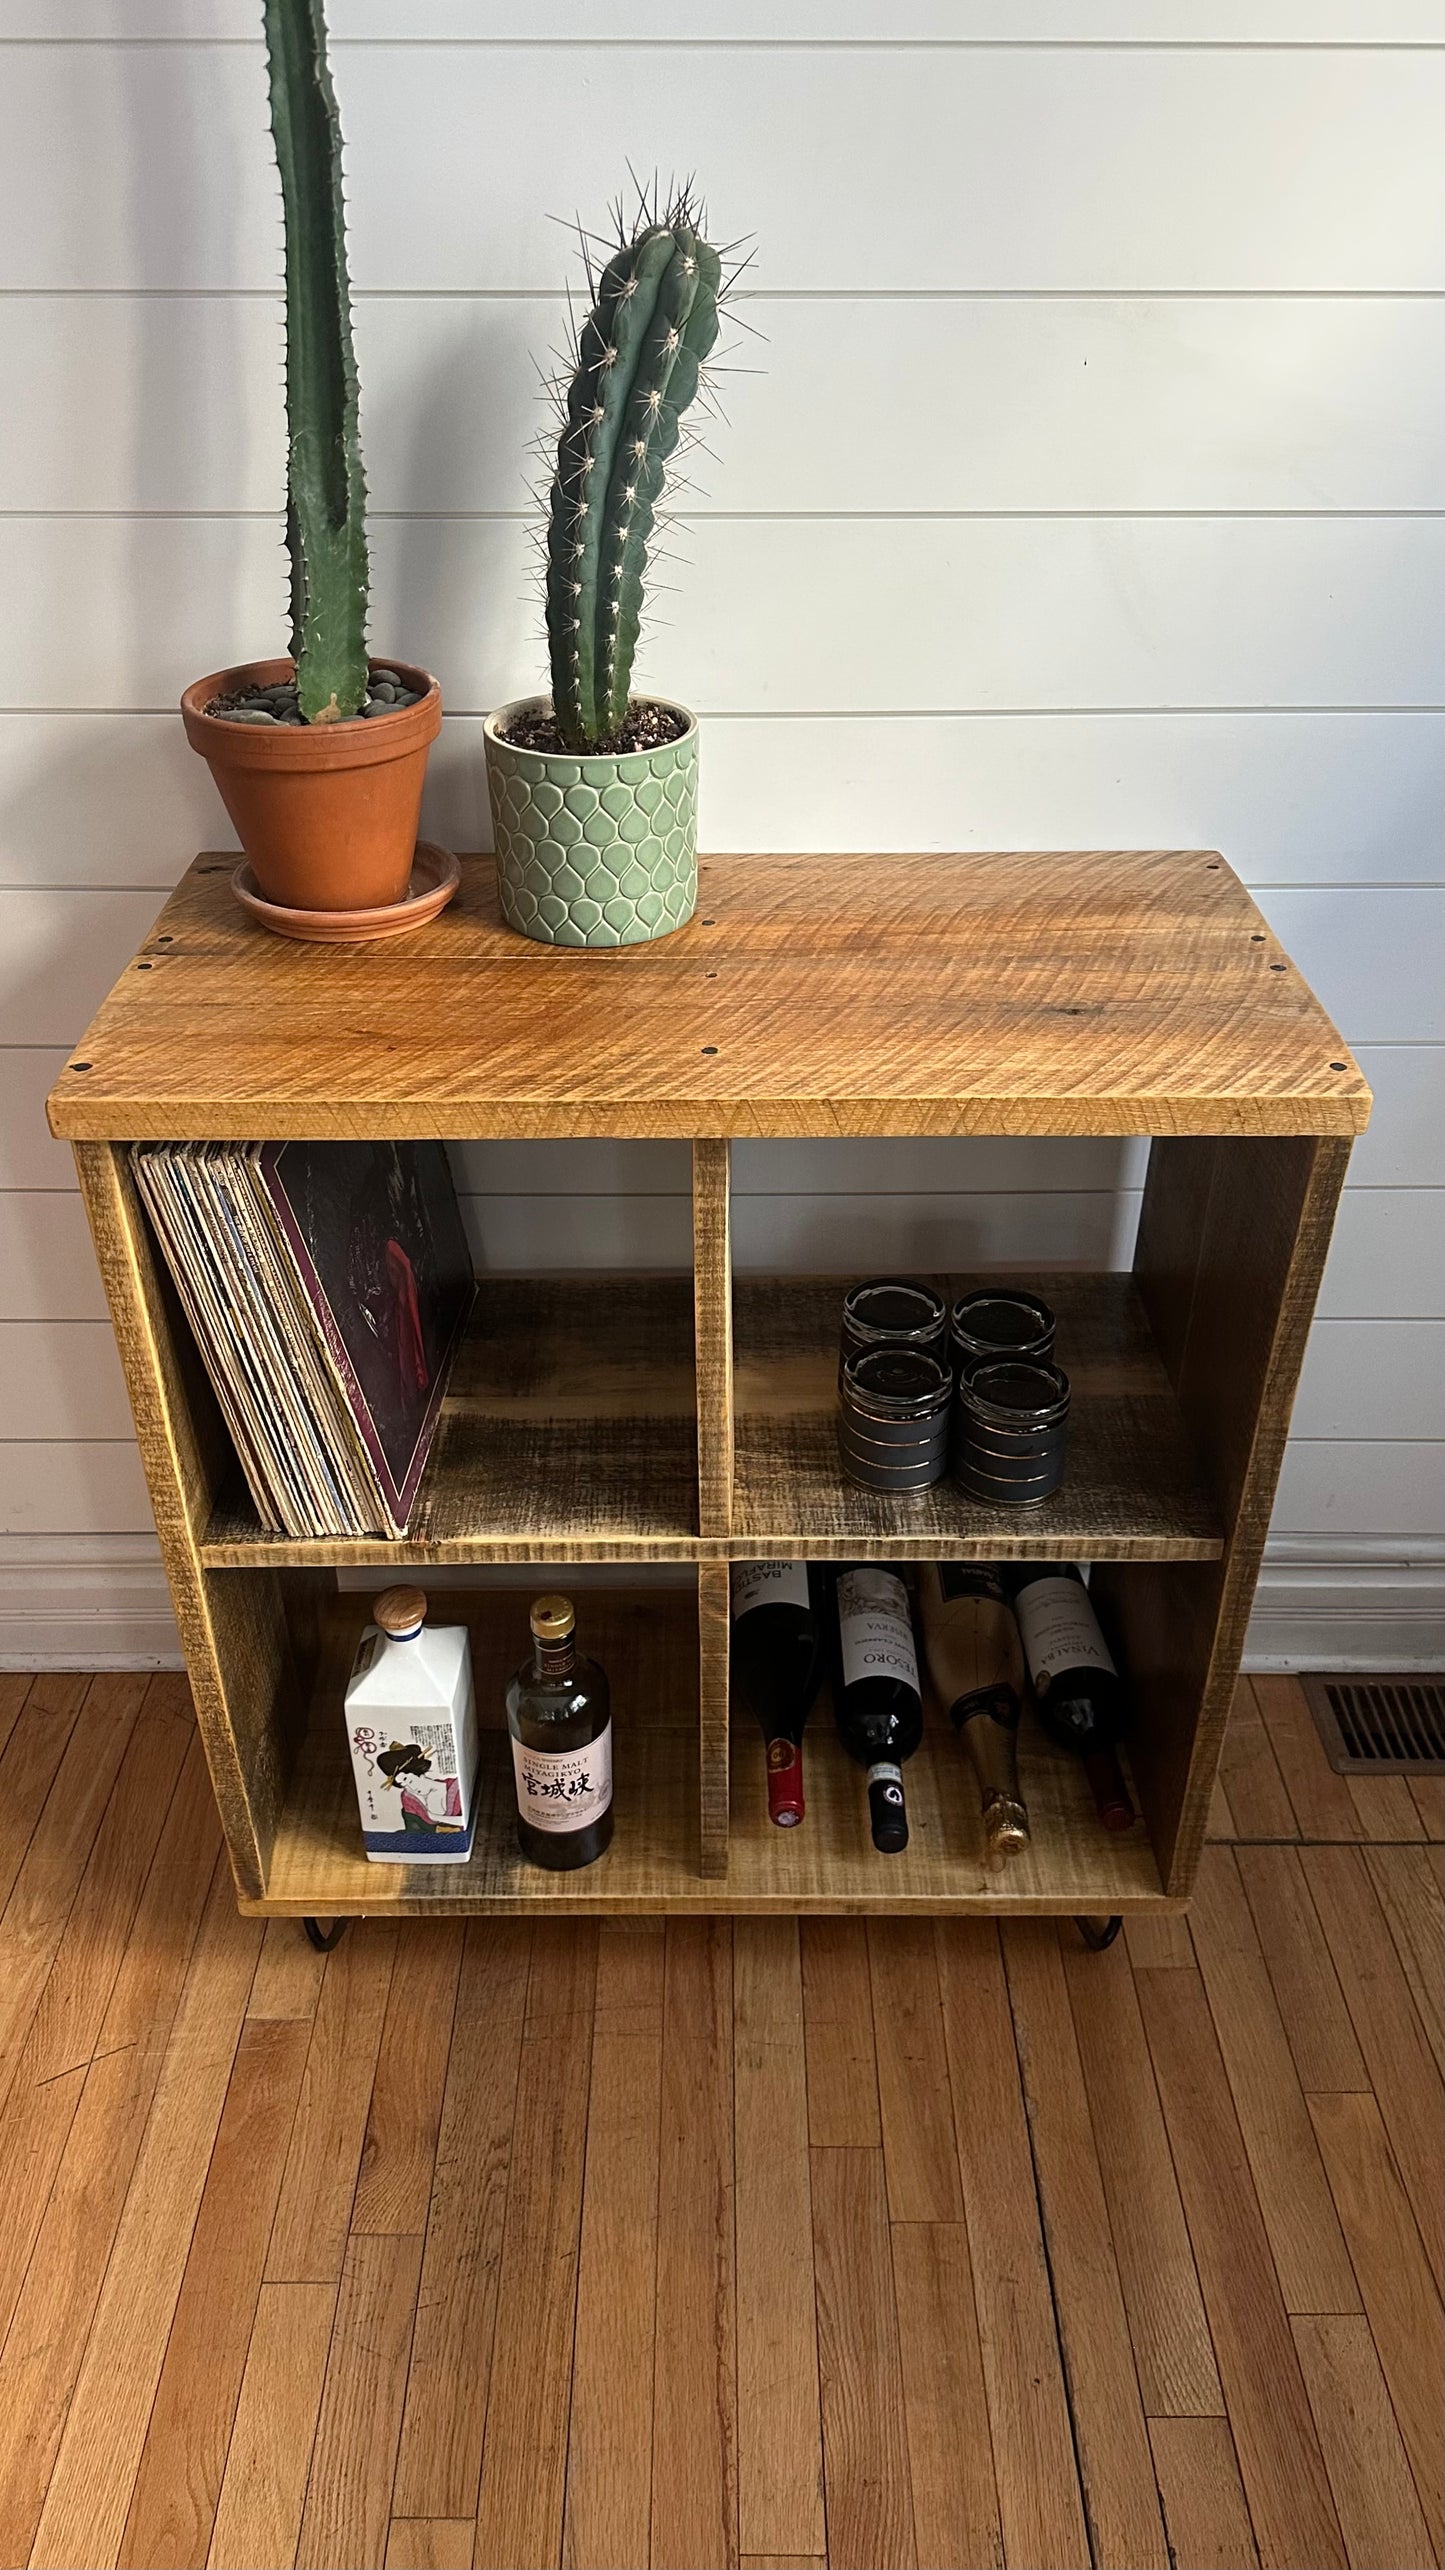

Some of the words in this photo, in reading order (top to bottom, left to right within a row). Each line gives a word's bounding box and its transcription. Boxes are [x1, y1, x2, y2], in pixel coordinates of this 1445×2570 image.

[864, 1653, 916, 1678] TESORO
[523, 1757, 559, 1771] SINGLE
[562, 1757, 588, 1769] MALT
[524, 1765, 581, 1777] MIYAGIKYO
[522, 1772, 594, 1801] 宮城峡
